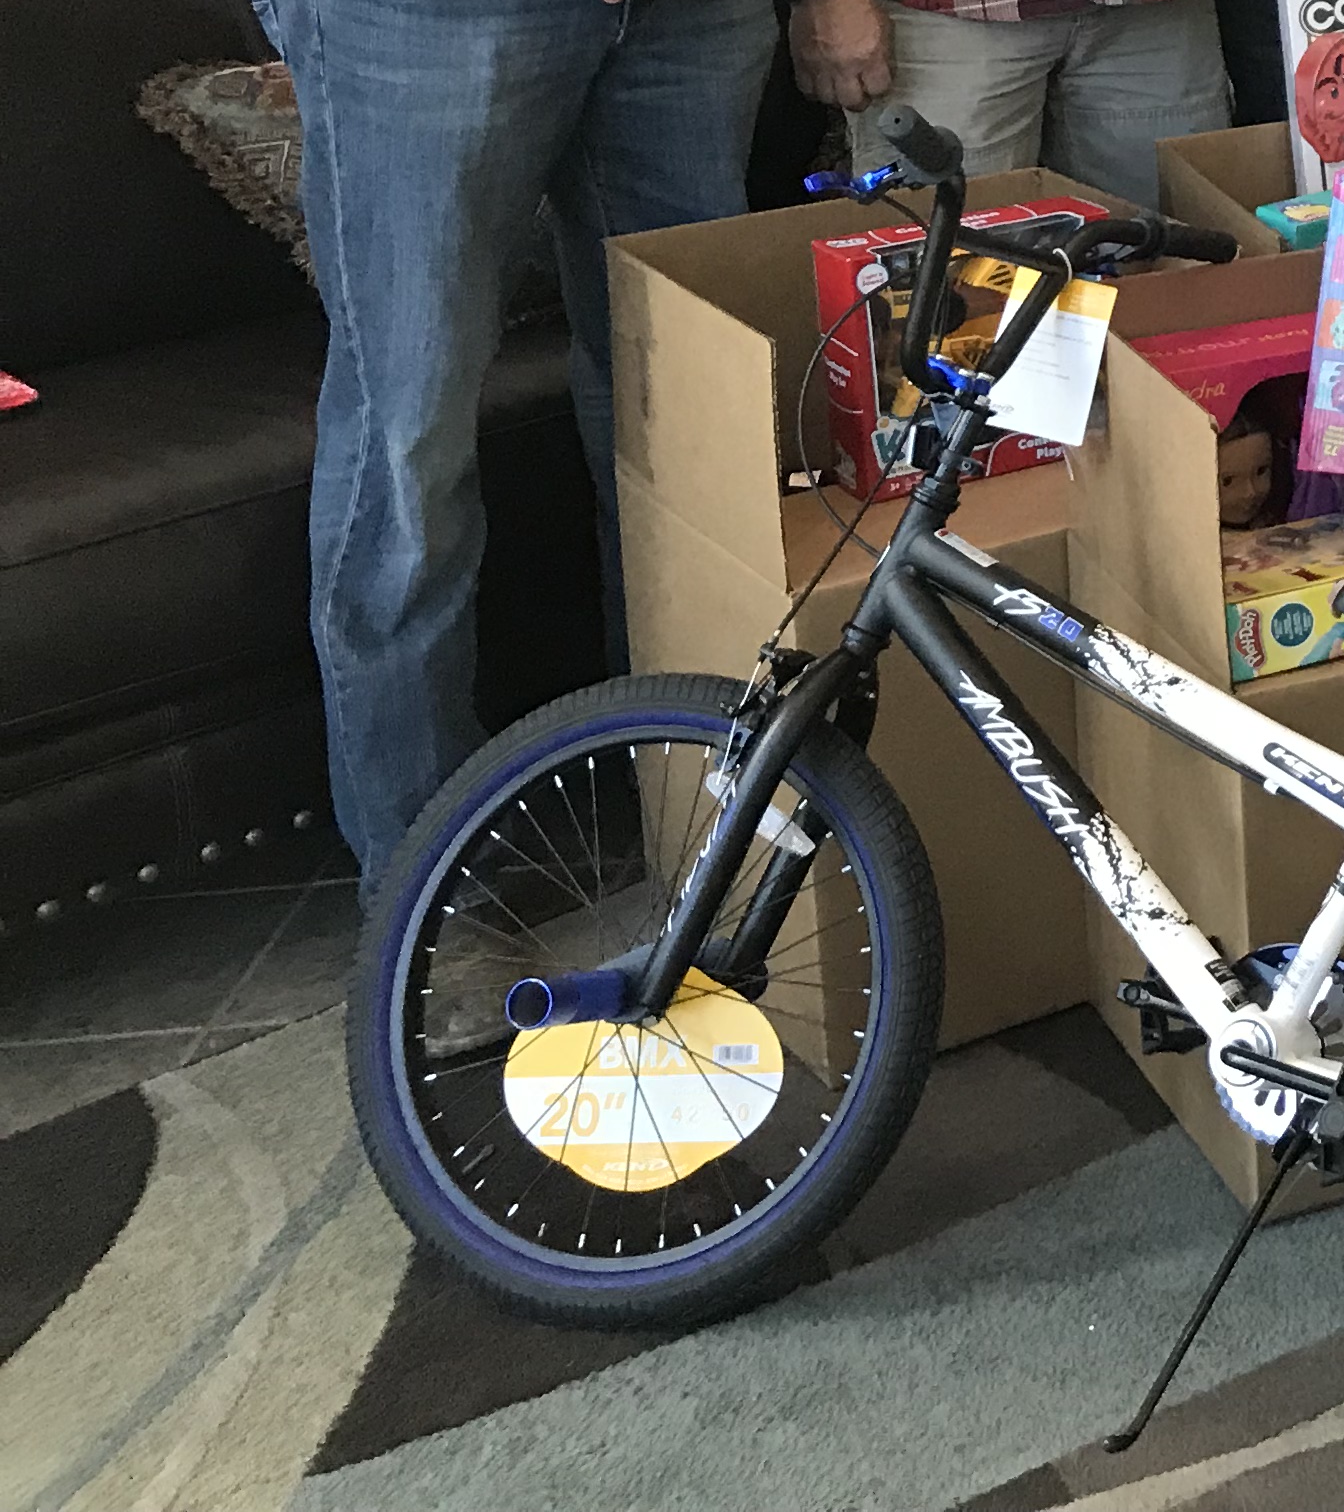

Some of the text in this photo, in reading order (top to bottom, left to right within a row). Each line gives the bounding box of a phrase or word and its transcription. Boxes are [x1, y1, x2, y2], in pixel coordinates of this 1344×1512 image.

[1238, 609, 1262, 668] Play-Doh
[959, 670, 1091, 835] AMBUSH
[600, 1035, 688, 1069] BMX
